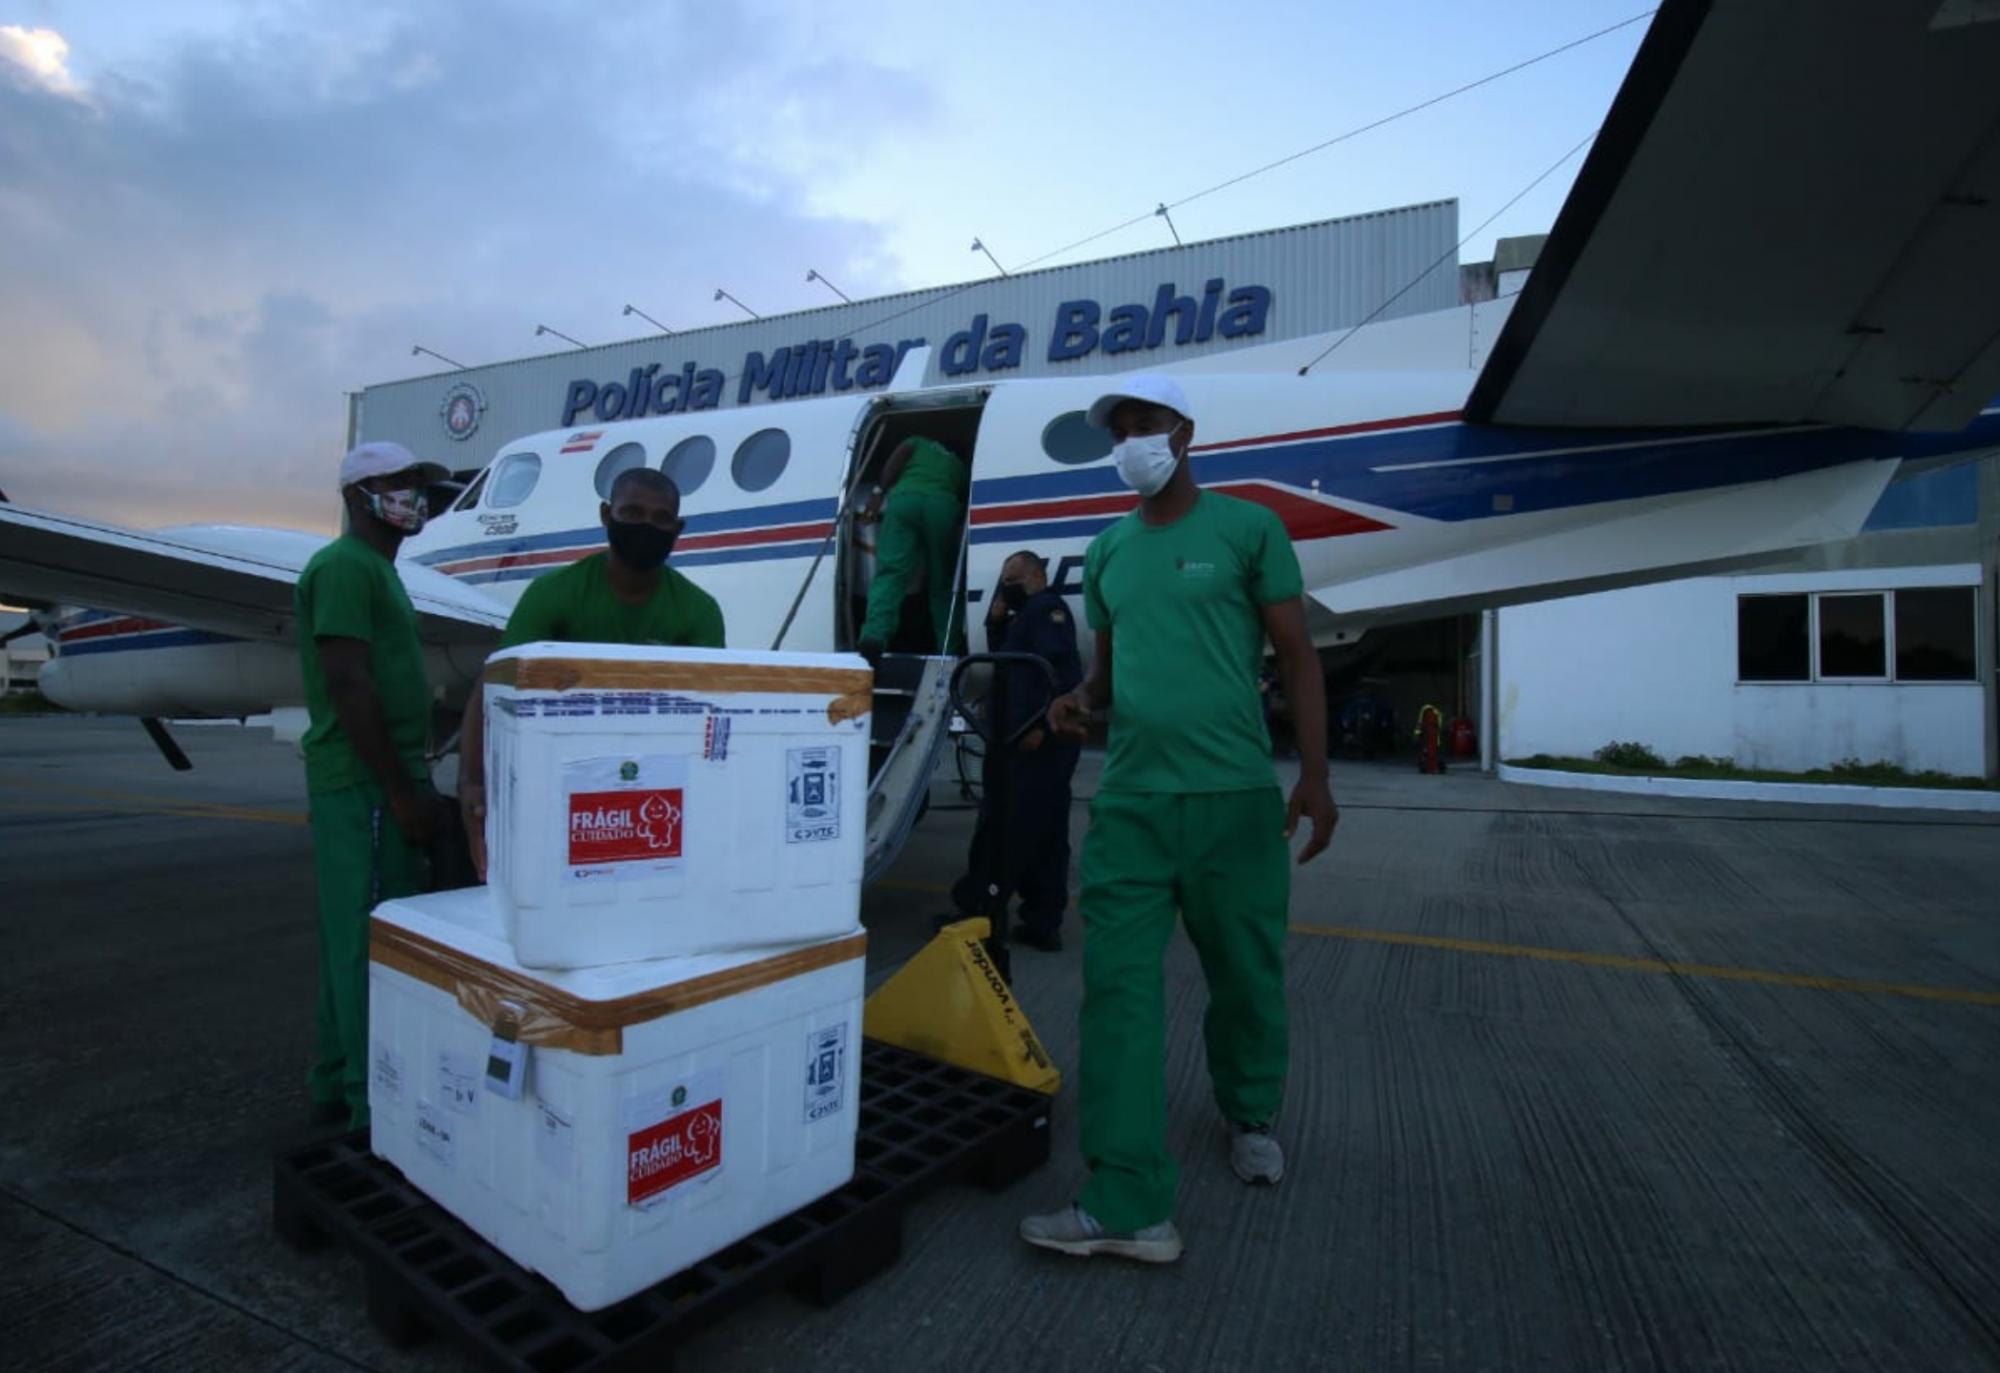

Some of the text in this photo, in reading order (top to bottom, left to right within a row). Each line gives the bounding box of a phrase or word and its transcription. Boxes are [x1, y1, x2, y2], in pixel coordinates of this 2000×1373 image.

[562, 277, 1272, 427] Polícia Militar da Bahia
[571, 806, 633, 831] FRÁGIL
[571, 829, 634, 842] CUIDADO
